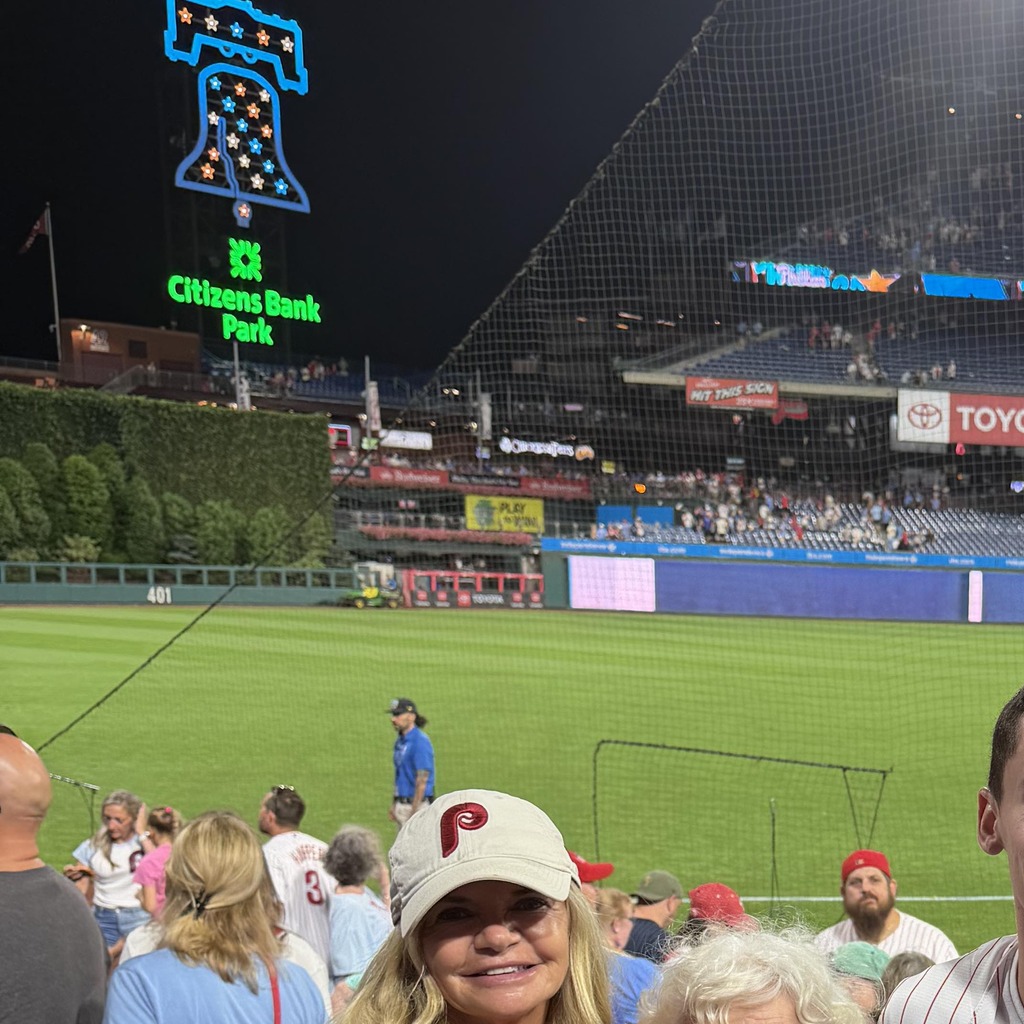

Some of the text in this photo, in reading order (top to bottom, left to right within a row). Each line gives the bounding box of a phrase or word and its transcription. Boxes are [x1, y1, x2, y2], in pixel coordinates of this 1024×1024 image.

[168, 275, 322, 323] Citizens Bank
[222, 313, 274, 346] Park
[690, 383, 774, 401] HIT THIS SIGN
[146, 586, 172, 604] 401
[441, 802, 489, 858] P
[305, 870, 324, 905] 3
